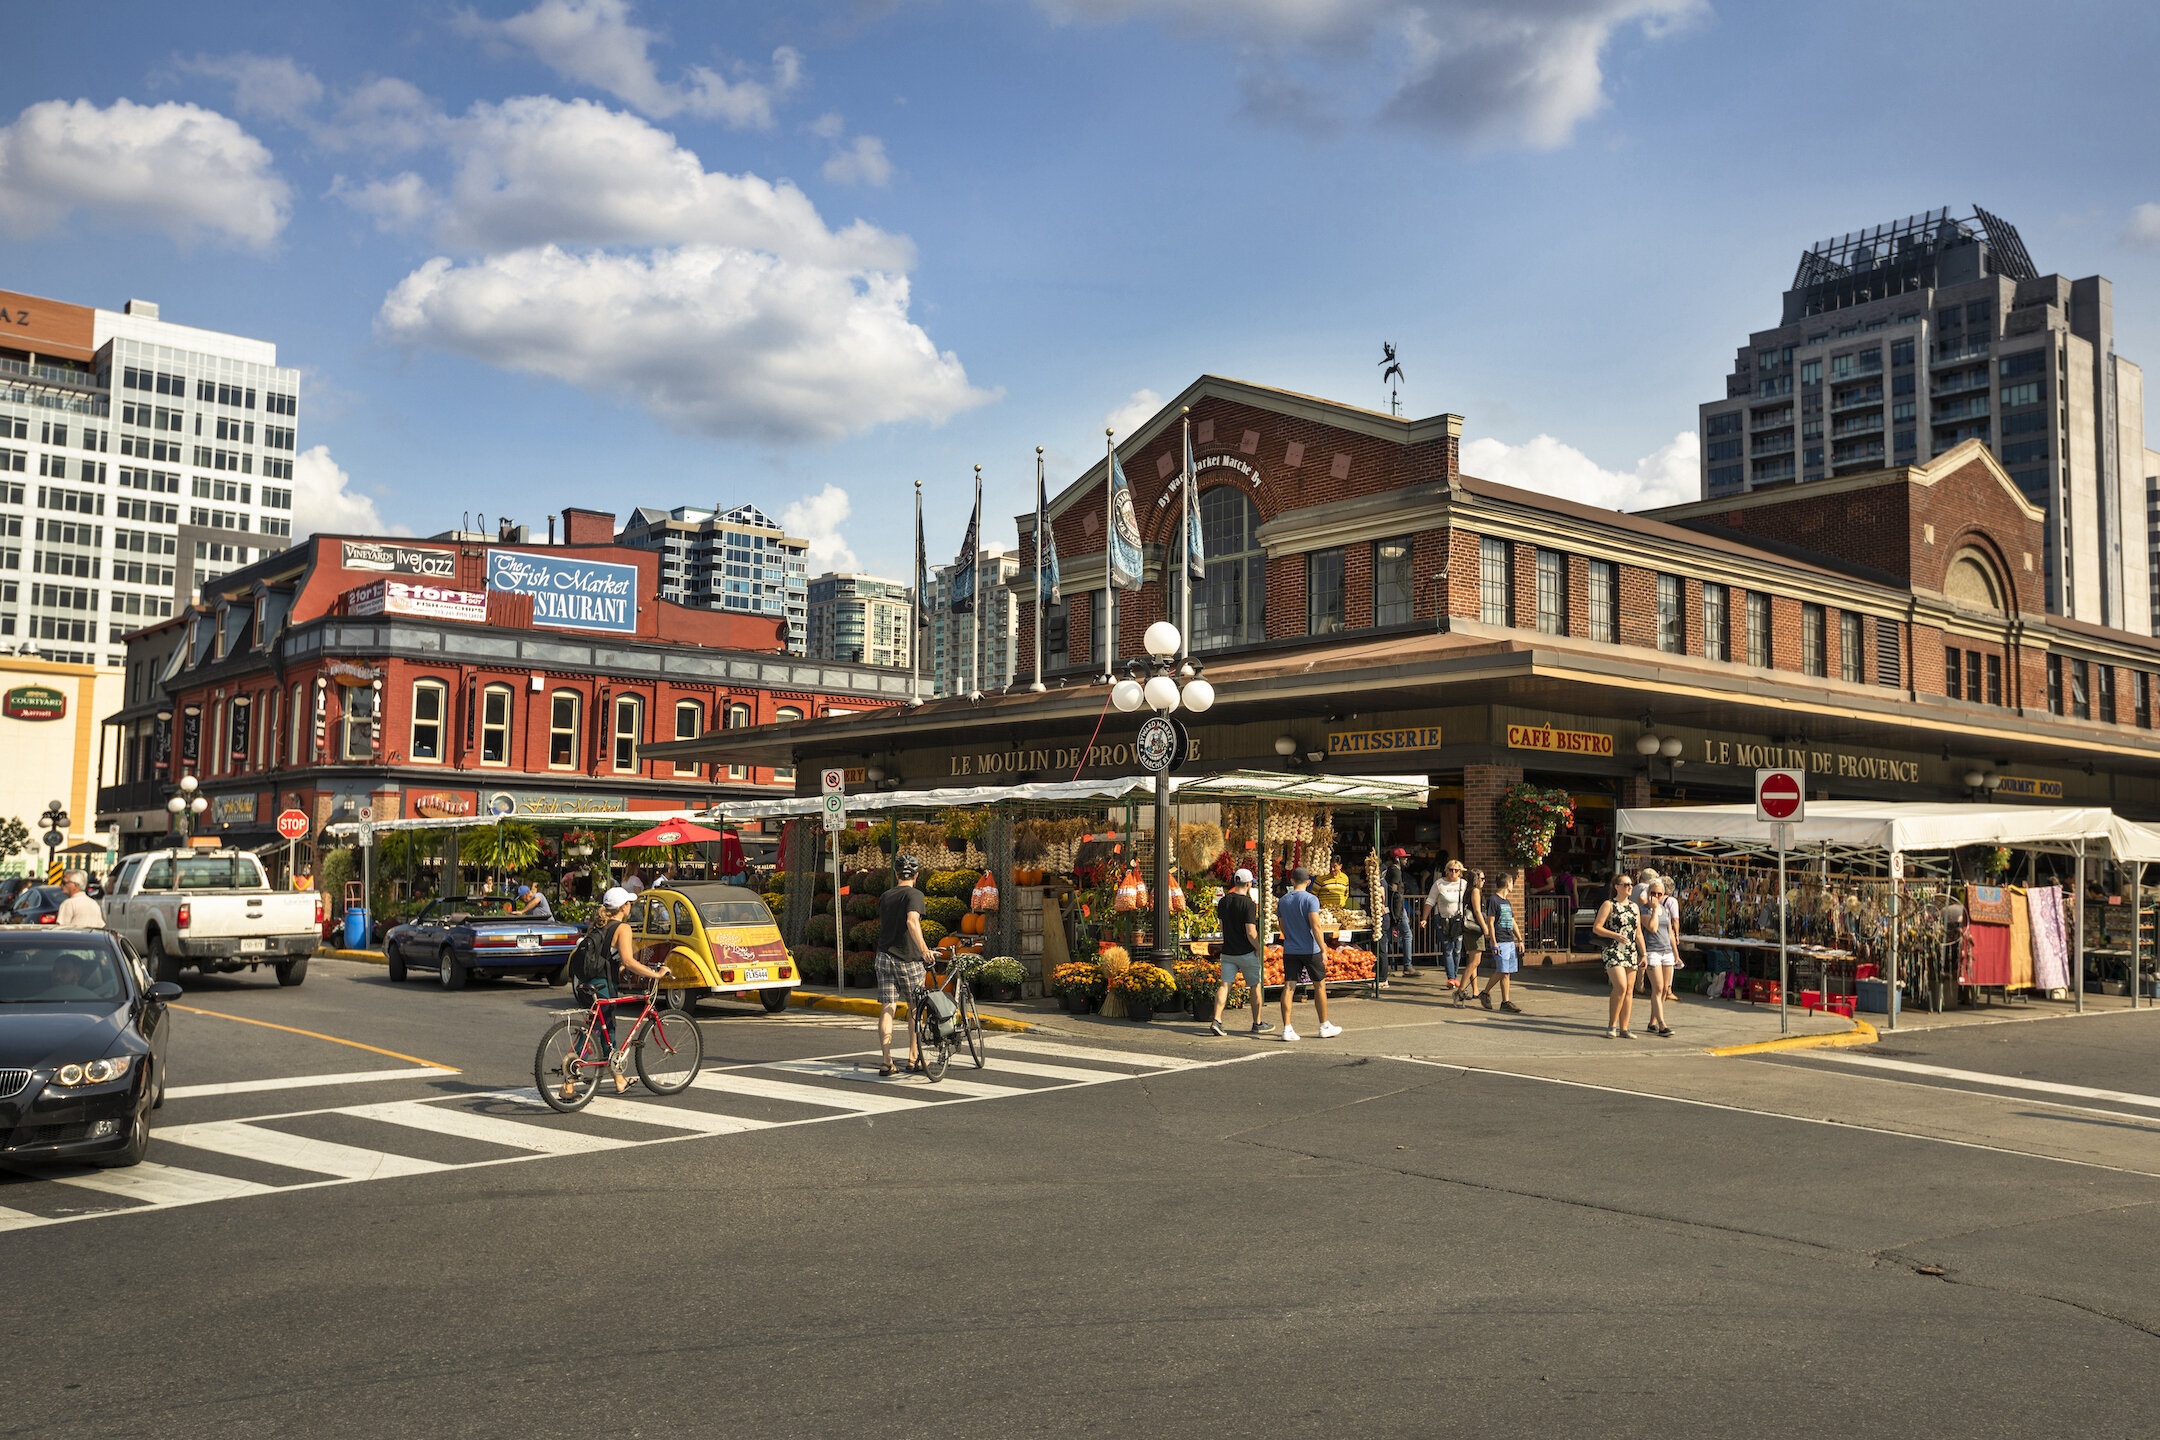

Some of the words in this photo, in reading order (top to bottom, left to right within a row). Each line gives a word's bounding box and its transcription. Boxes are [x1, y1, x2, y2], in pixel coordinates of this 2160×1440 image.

[1158, 492, 1170, 508] By
[1167, 473, 1186, 493] War
[1250, 470, 1262, 488] By
[494, 554, 523, 571] The
[494, 564, 551, 590] Fish
[553, 569, 630, 595] Market
[514, 588, 627, 624] STAURANT
[11, 697, 62, 706] COURTYARD
[1330, 729, 1439, 752] PATISSERIE
[1509, 724, 1551, 748] CAFÉ
[1556, 731, 1612, 753] BISTRO
[950, 755, 971, 776] LE
[977, 748, 1050, 774] MOULIN
[1055, 747, 1081, 769] DE
[1089, 739, 1201, 767] PROVE
[1704, 739, 1730, 765] LE
[1736, 743, 1806, 769] MOULIN
[1811, 751, 1832, 774] DE
[1838, 754, 1919, 783] PROVENCE
[2040, 782, 2061, 796] FOOD
[280, 819, 306, 831] STOP
